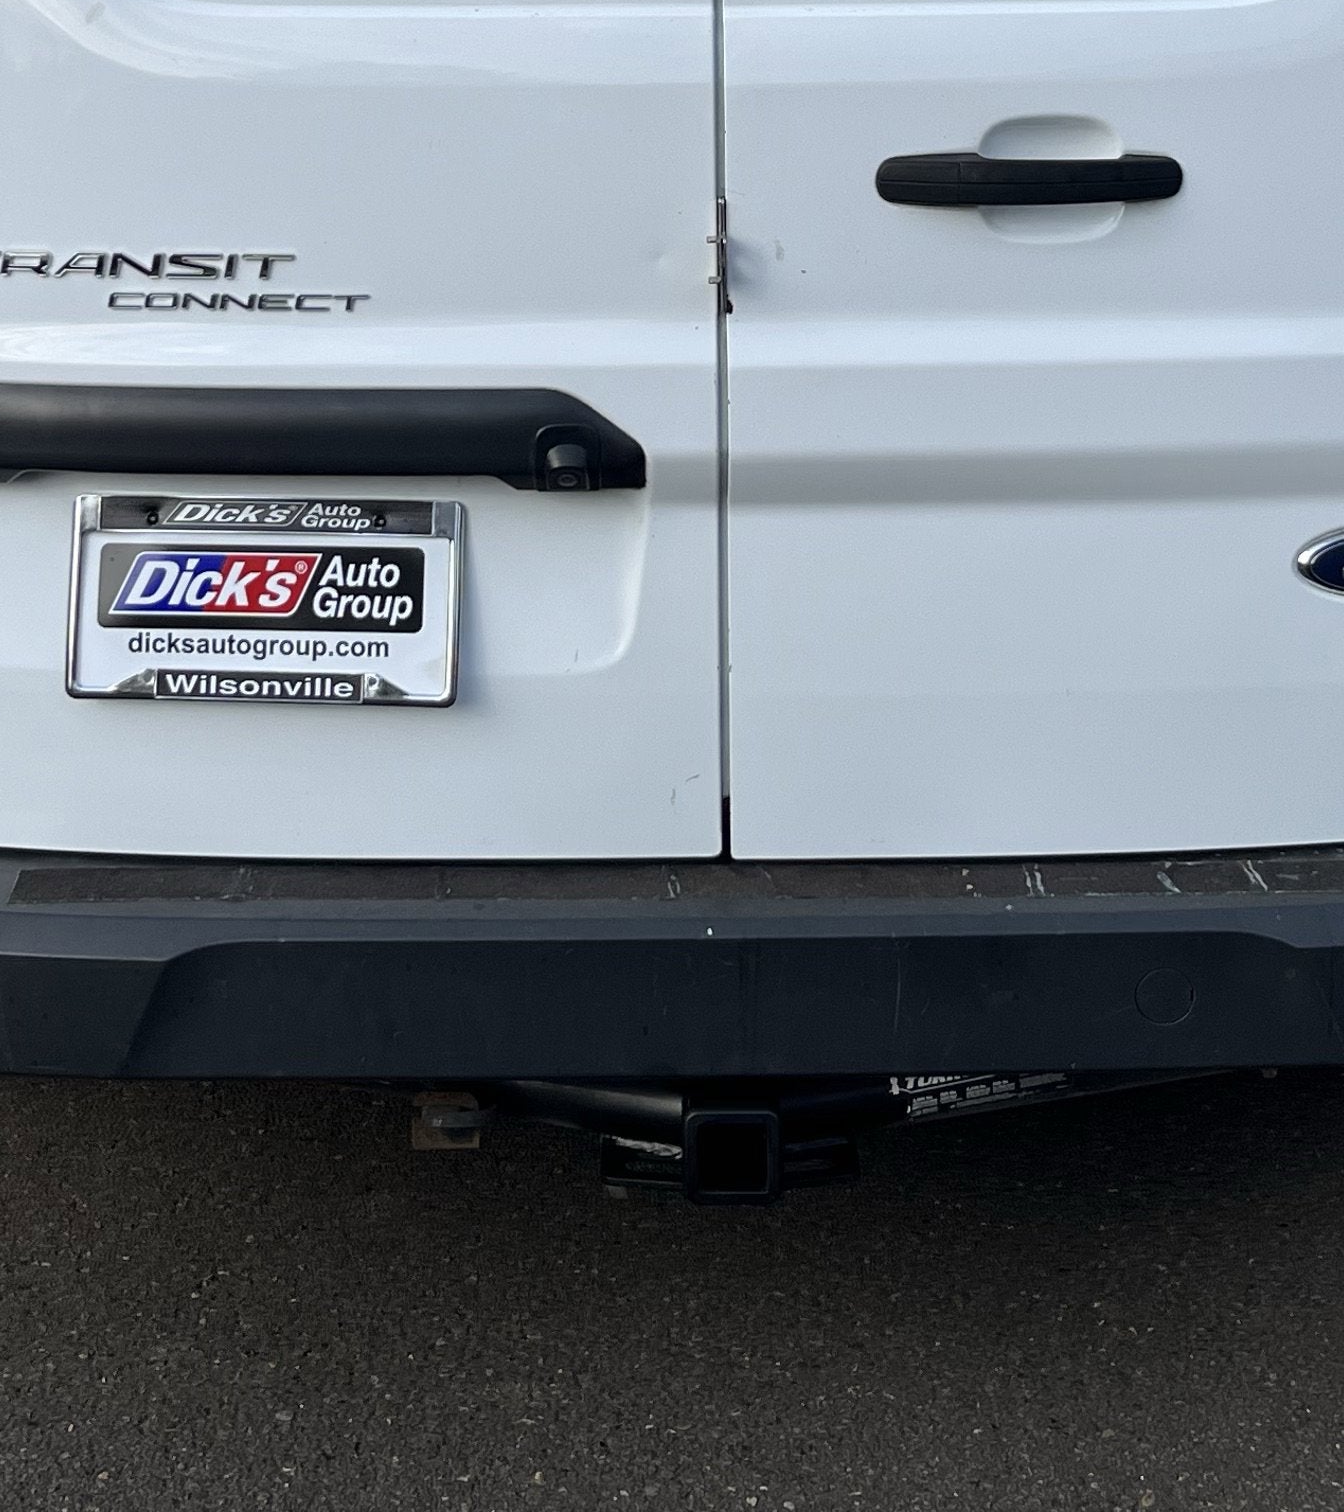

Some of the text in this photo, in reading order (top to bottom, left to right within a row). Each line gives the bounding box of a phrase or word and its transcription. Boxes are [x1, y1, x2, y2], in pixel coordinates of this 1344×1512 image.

[108, 292, 371, 312] CONNECT
[173, 501, 362, 524] Dick's Auto
[301, 514, 371, 531] Group
[124, 554, 401, 608] Dick's Auto
[312, 588, 414, 626] Group
[128, 632, 390, 660] dicksautogroup.com
[165, 673, 354, 698] Wilsonville
